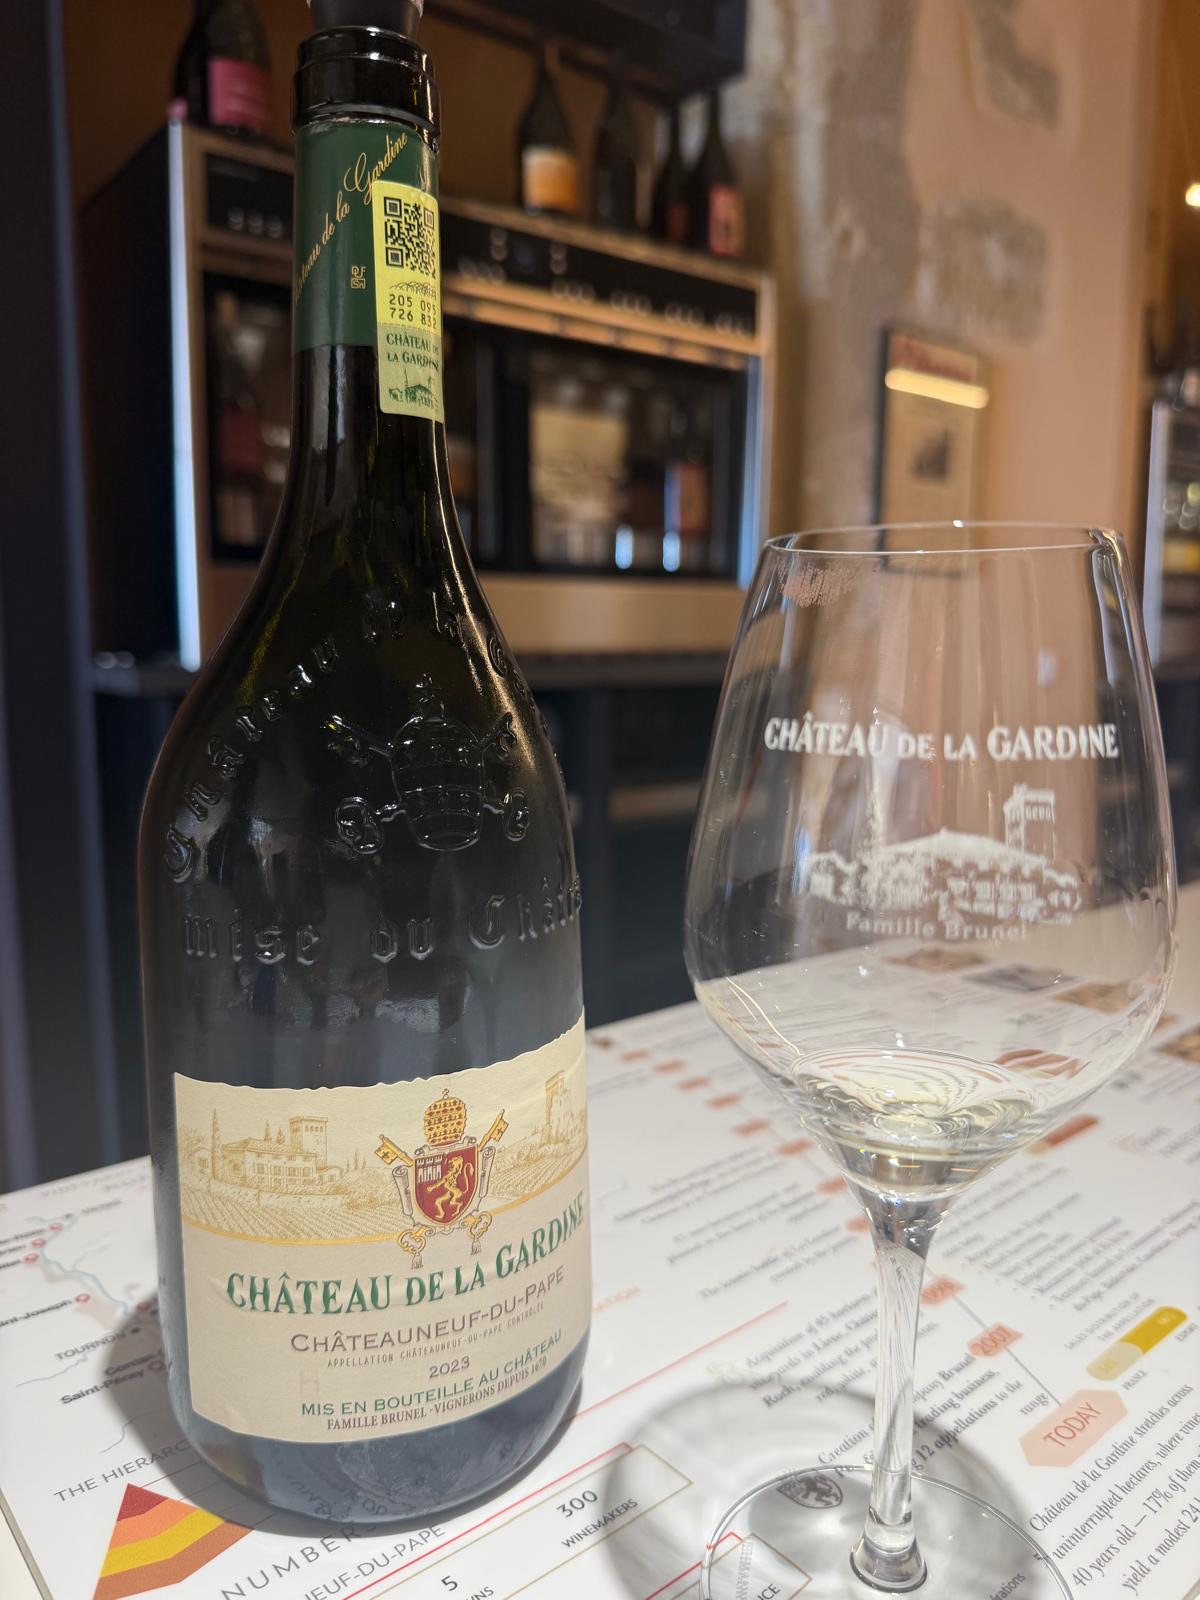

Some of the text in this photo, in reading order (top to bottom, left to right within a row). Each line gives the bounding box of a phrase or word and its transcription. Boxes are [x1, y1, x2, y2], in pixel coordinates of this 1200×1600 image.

[321, 212, 336, 246] de
[335, 191, 350, 223] la
[343, 132, 408, 205] Gardine
[388, 294, 437, 316] 205 095
[388, 308, 437, 330] 726 832
[387, 352, 399, 363] LA
[763, 711, 1120, 762] CHÂTEAU DE LA GARDINE
[846, 911, 1028, 942] Famille Brunel
[226, 1189, 584, 1315] CHÂTEAU DE LA GARDINE
[54, 1330, 127, 1362] TOURNON
[970, 1325, 1012, 1355] 2001
[301, 1327, 562, 1416] MIS EN BOUTEILLE AU CHÂTEAU
[327, 1353, 394, 1369] APPELLATION
[429, 1355, 470, 1379] 2023
[327, 1413, 378, 1430] FAMILLE
[381, 1407, 428, 1426] BRUNEL
[496, 1369, 529, 1393] DEPUIS
[912, 1397, 961, 1430] trading
[1019, 1392, 1050, 1416] range
[915, 1443, 936, 1462] 12
[933, 1398, 998, 1448] appellations
[1043, 1401, 1102, 1447] TODAY
[818, 1430, 870, 1464] Creation
[53, 1438, 192, 1502] THE HIERARC
[1029, 1489, 1079, 1533] Château
[1074, 1477, 1092, 1494] de
[1086, 1467, 1103, 1483] la
[1095, 1433, 1138, 1473] Gardine
[1134, 1405, 1171, 1439] stretches
[1167, 1475, 1187, 1493] of
[1174, 1458, 1200, 1482] them
[556, 1490, 598, 1518] 300
[1052, 1490, 1124, 1561] uninterrupted
[1114, 1459, 1163, 1496] hectares,
[1155, 1432, 1185, 1460] where
[1142, 1487, 1174, 1515] 17%
[561, 1498, 638, 1548] WINEMAKERS
[1116, 1524, 1137, 1547] old
[1089, 1543, 1121, 1578] years
[1121, 1503, 1200, 1597] yield a modest 24
[440, 1575, 458, 1592] 5
[1072, 1566, 1094, 1587] 40
